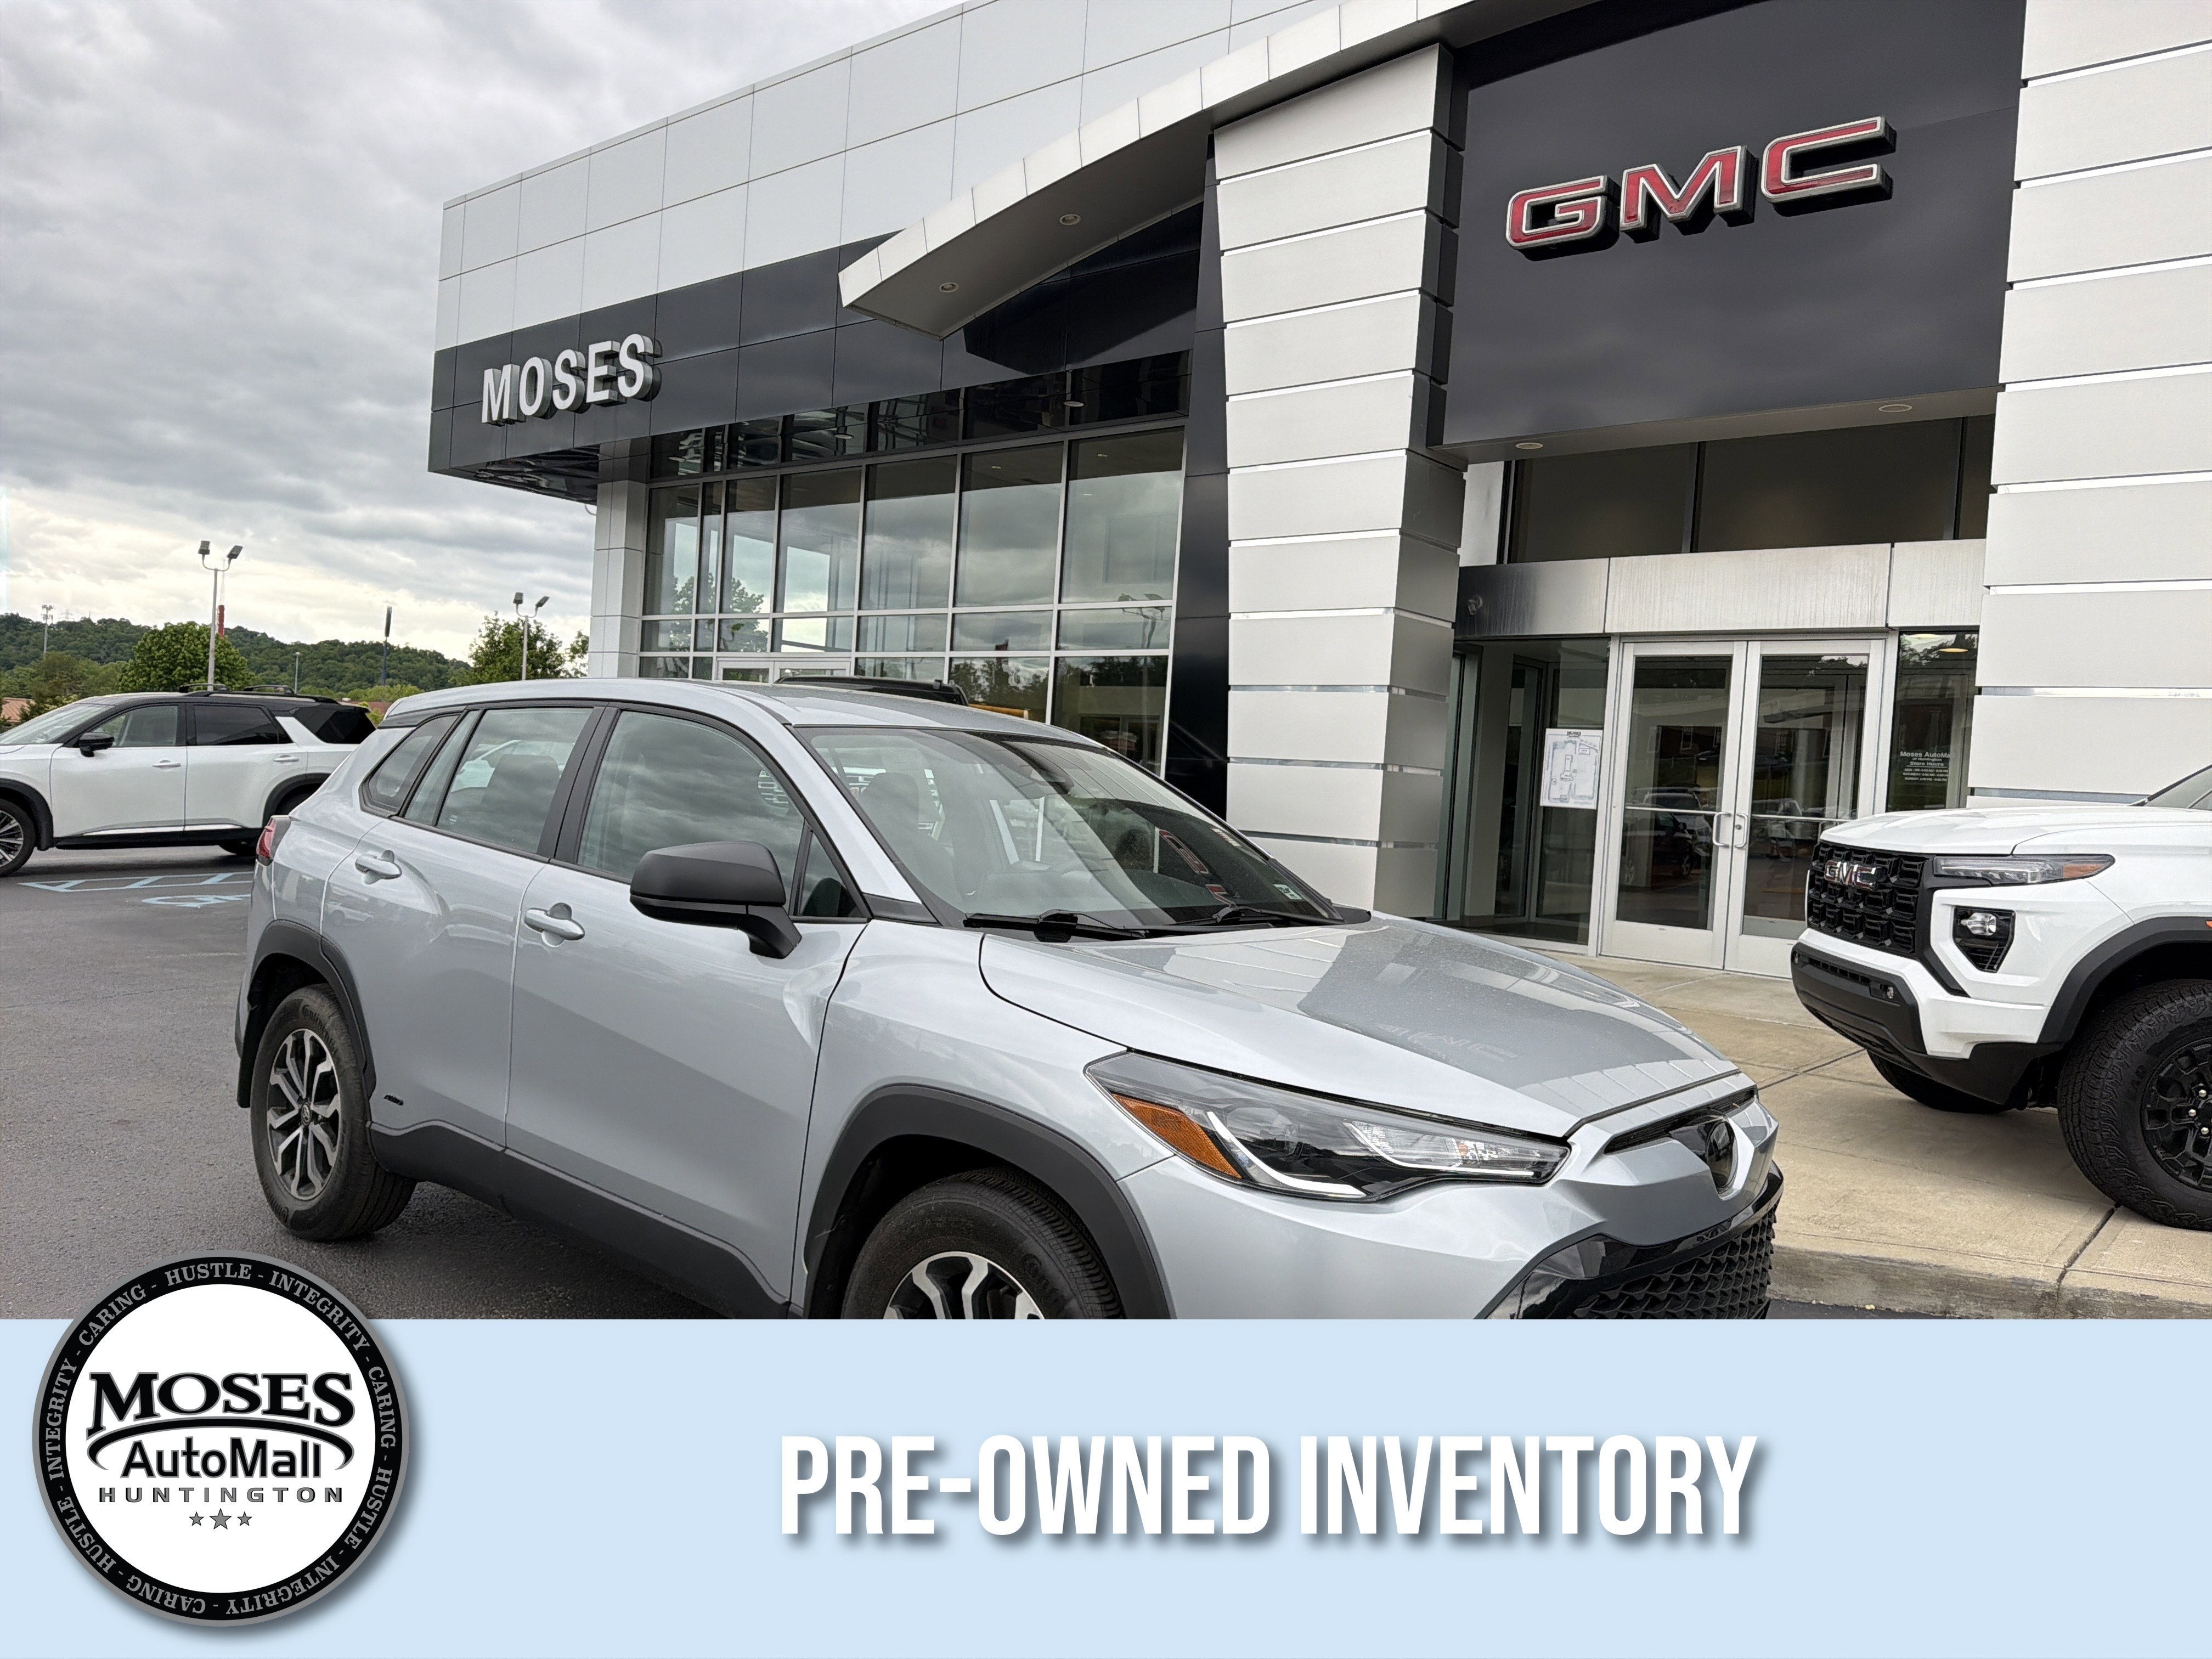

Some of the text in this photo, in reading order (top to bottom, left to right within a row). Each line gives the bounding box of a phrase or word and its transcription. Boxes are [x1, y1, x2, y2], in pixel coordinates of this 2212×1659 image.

[1505, 116, 1887, 251] GMC
[482, 333, 654, 426] MOSES
[1824, 860, 1876, 891] GMC
